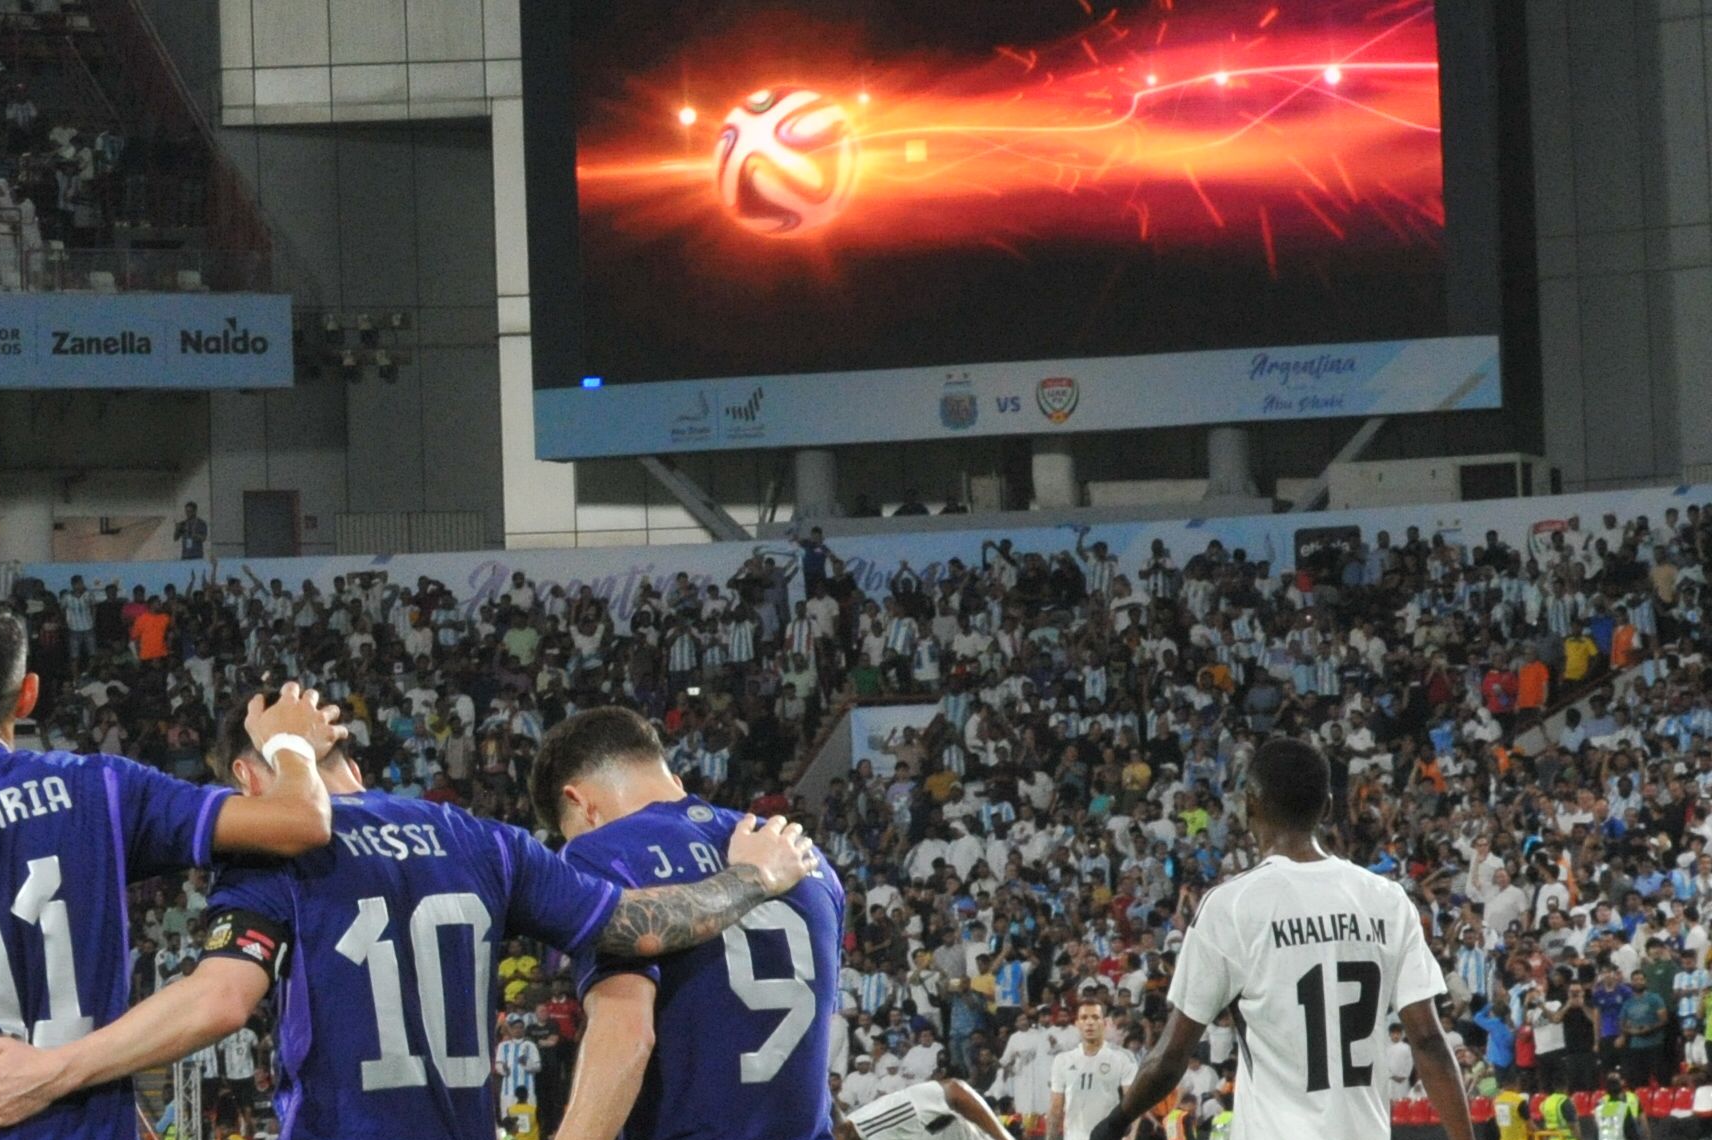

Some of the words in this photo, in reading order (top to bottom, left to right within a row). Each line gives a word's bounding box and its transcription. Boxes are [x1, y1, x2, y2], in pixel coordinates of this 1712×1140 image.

[51, 330, 152, 355] Zanella
[180, 324, 269, 356] Naldo
[337, 823, 447, 861] MESSI
[648, 845, 684, 879] J.
[1271, 913, 1361, 948] KHALIFA
[335, 892, 492, 1092] 10
[722, 899, 816, 1084] 9
[1296, 961, 1382, 1093] 12
[1080, 1072, 1094, 1090] 11
